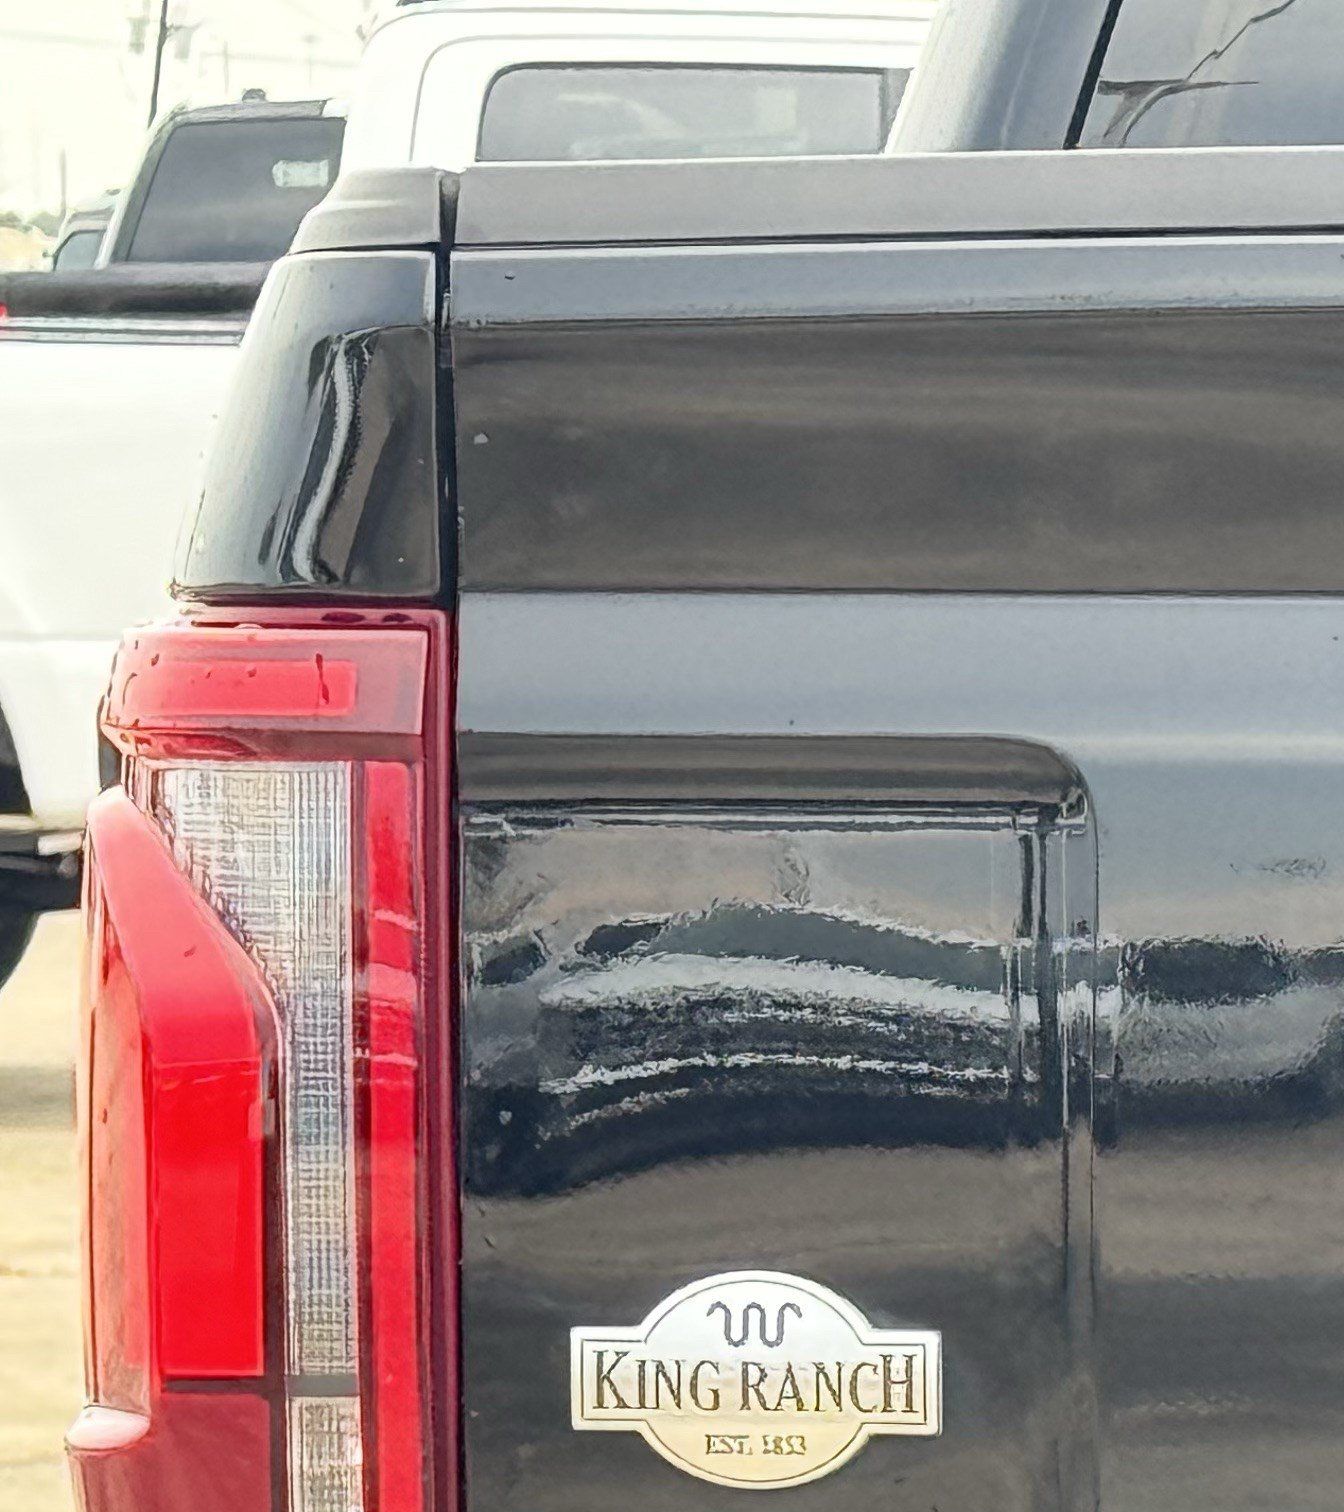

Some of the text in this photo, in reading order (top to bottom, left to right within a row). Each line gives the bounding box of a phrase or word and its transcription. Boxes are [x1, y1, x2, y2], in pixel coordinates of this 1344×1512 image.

[592, 1349, 920, 1415] KING RANCH
[762, 1434, 806, 1455] 1853
